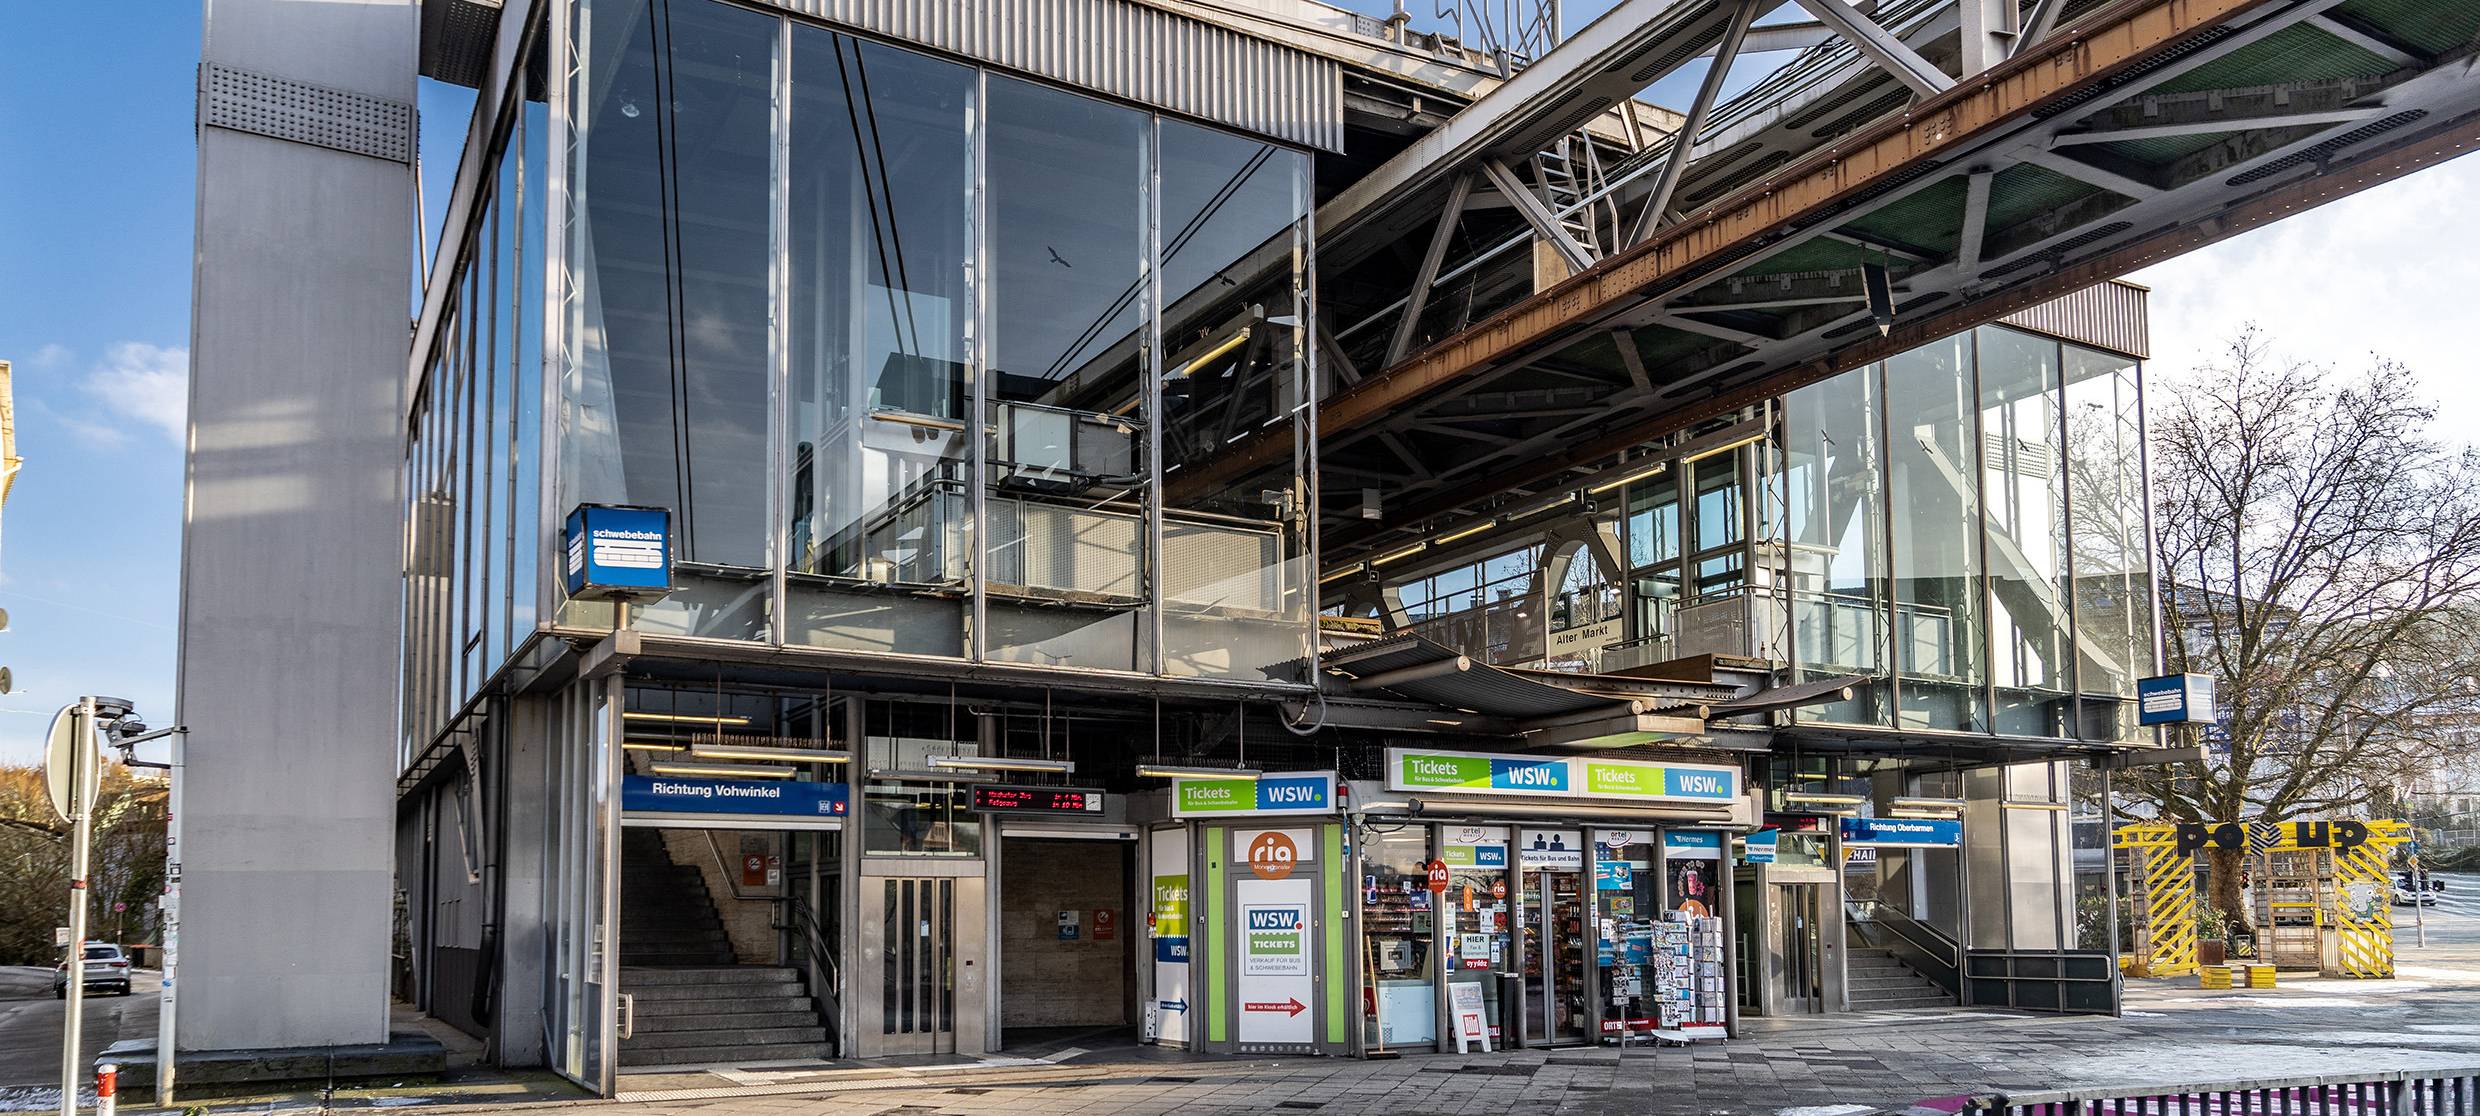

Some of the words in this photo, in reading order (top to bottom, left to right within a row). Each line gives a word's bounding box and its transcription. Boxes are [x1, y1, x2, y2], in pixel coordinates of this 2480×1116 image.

[593, 529, 662, 541] schwebebahn
[1556, 632, 1578, 645] Alter
[1582, 625, 1608, 640] Markt
[2143, 688, 2182, 698] schwebebahn
[1412, 760, 1458, 775] Tickets
[1595, 768, 1636, 784] Tickets
[653, 783, 712, 798] Richtung
[716, 785, 780, 798] Vohwinkel
[1185, 786, 1231, 799] Tickets
[1869, 822, 1897, 833] Richtung
[1898, 823, 1934, 833] Oberbarmen
[1681, 835, 1703, 844] Hermes
[1254, 837, 1291, 862] ria
[1429, 863, 1447, 881] ria
[1157, 886, 1188, 902] Tickets
[1493, 884, 1505, 893] ria
[1252, 912, 1294, 928] WSW
[1254, 940, 1296, 949] TICKETS
